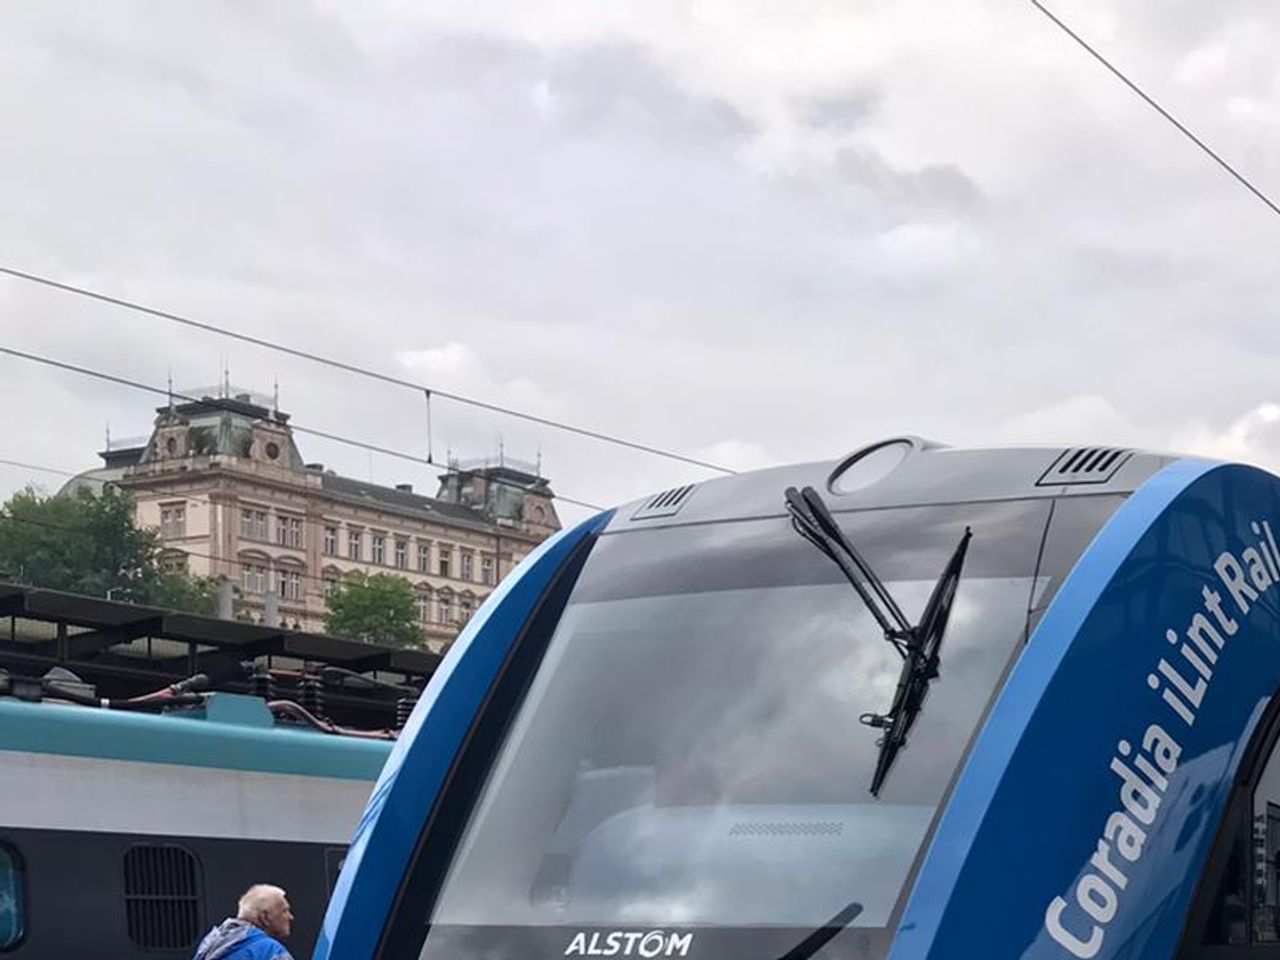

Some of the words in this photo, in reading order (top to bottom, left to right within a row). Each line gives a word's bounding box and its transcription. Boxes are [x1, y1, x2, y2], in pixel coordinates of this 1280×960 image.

[1045, 739, 1183, 960] Coradia
[1148, 585, 1239, 727] iLint
[564, 929, 694, 958] ALSTOM
